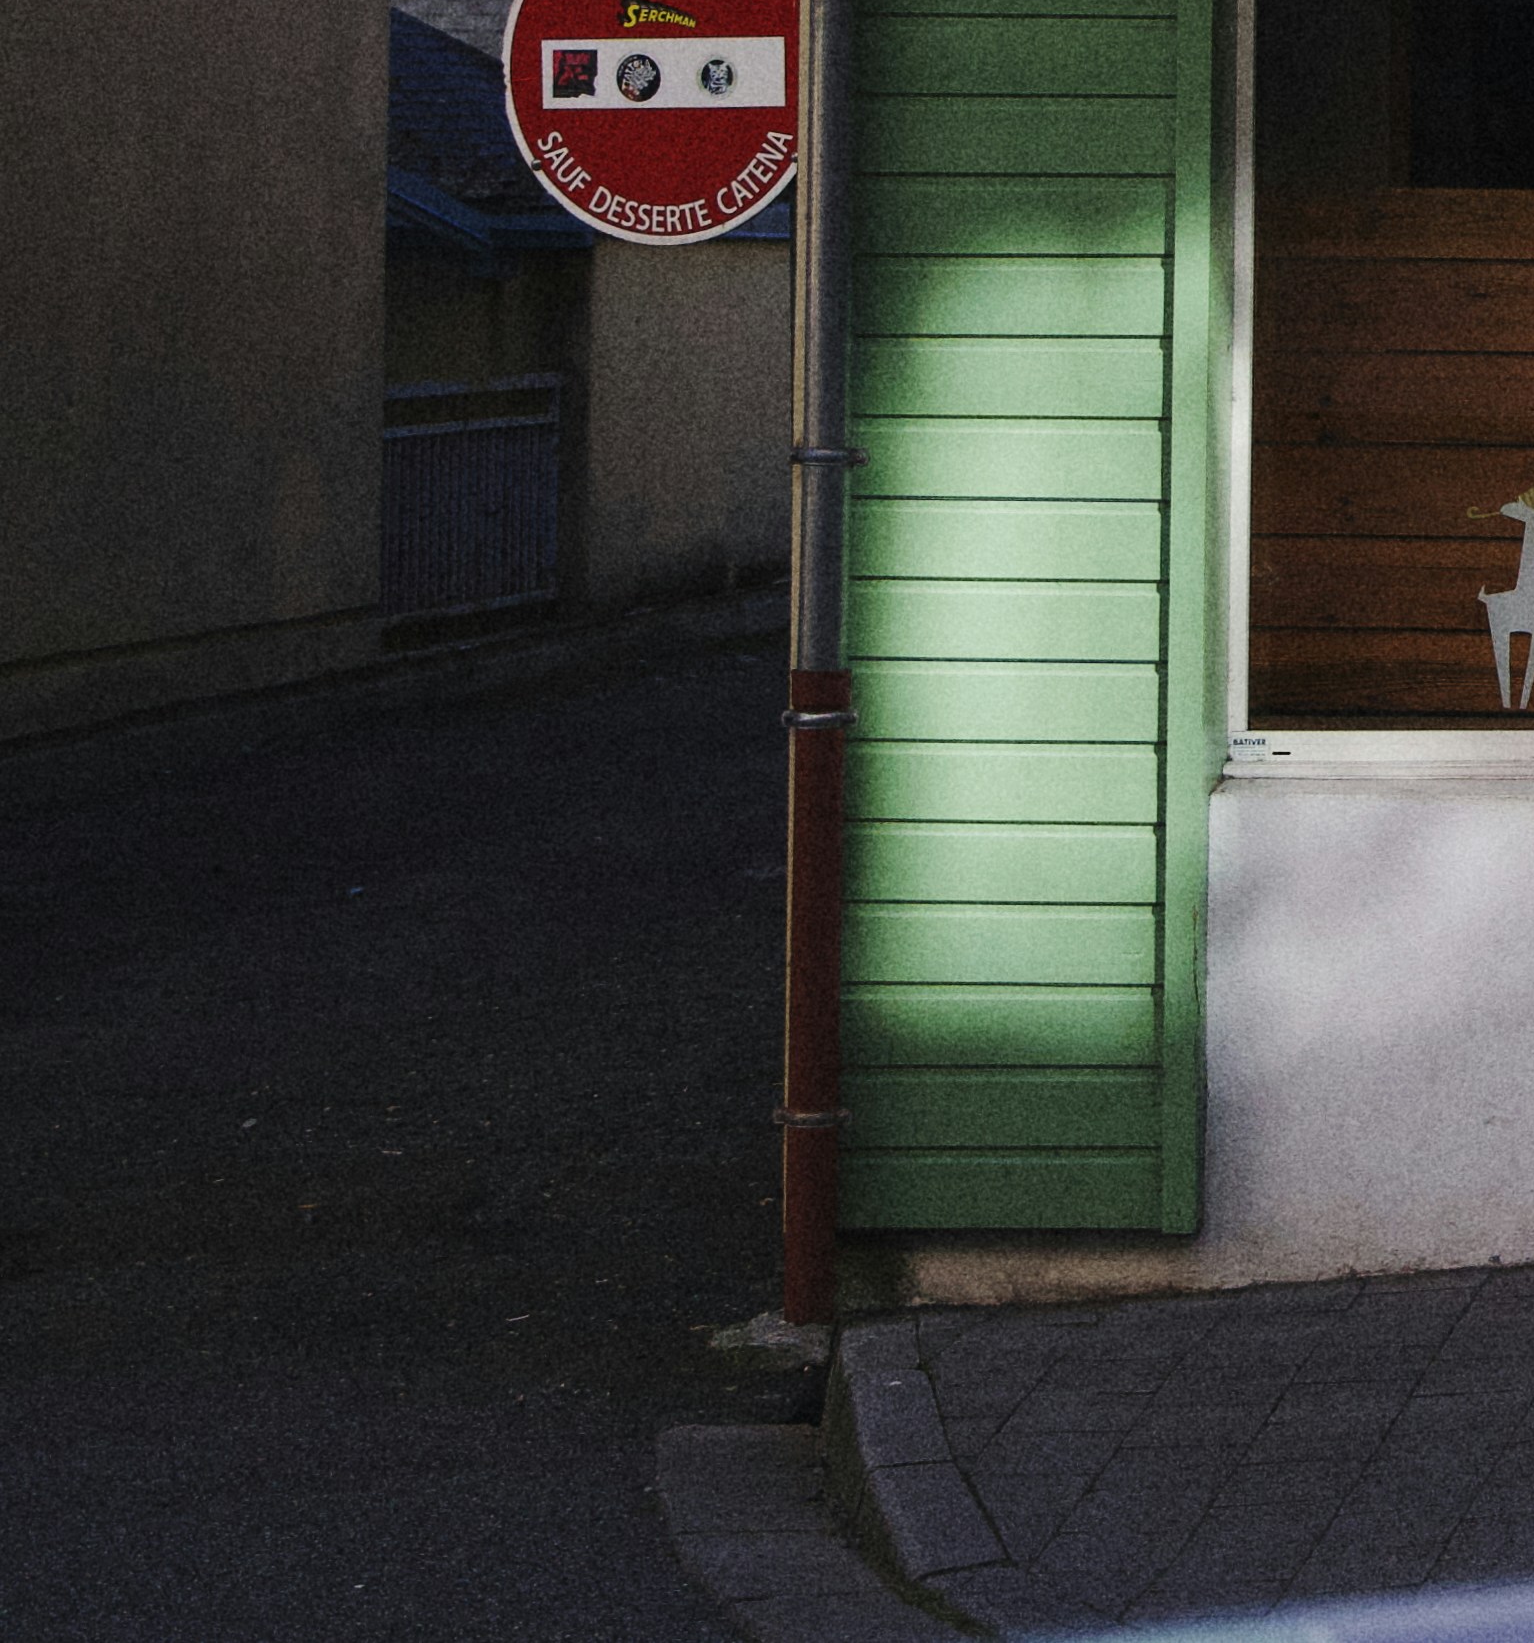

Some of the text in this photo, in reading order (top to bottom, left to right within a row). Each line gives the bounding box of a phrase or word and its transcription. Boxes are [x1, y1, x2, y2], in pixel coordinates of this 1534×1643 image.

[623, 4, 697, 28] SERCHMAN
[537, 129, 794, 234] SAUF DESSERTE CATENA
